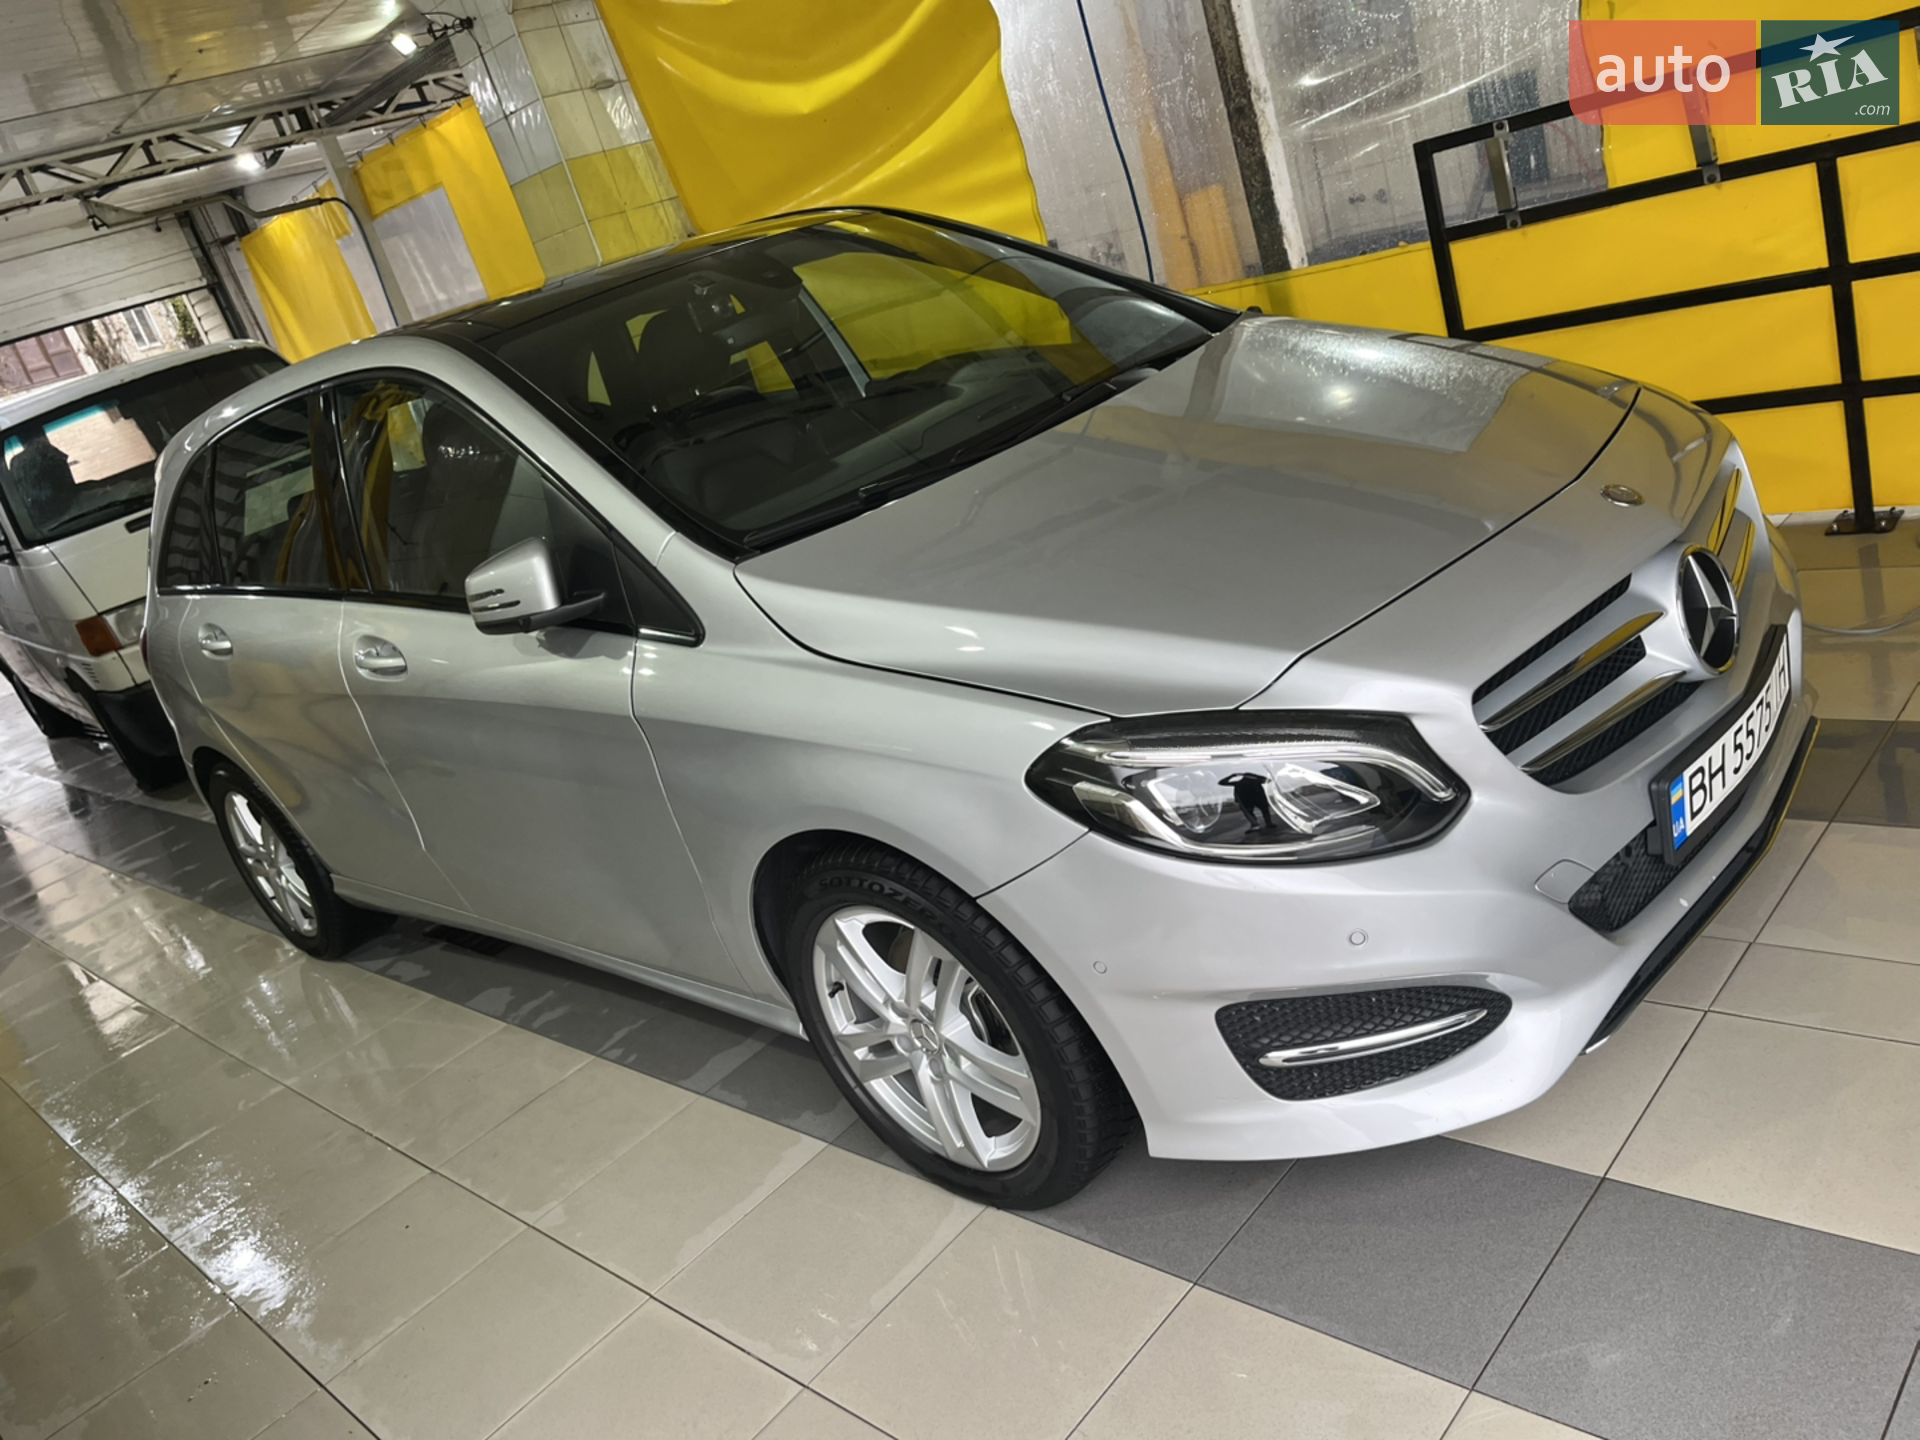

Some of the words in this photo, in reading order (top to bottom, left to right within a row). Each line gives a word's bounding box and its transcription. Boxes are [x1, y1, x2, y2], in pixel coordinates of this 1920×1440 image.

[1689, 743, 1726, 821] BH
[1733, 683, 1772, 775] 5575
[1673, 816, 1685, 837] UA
